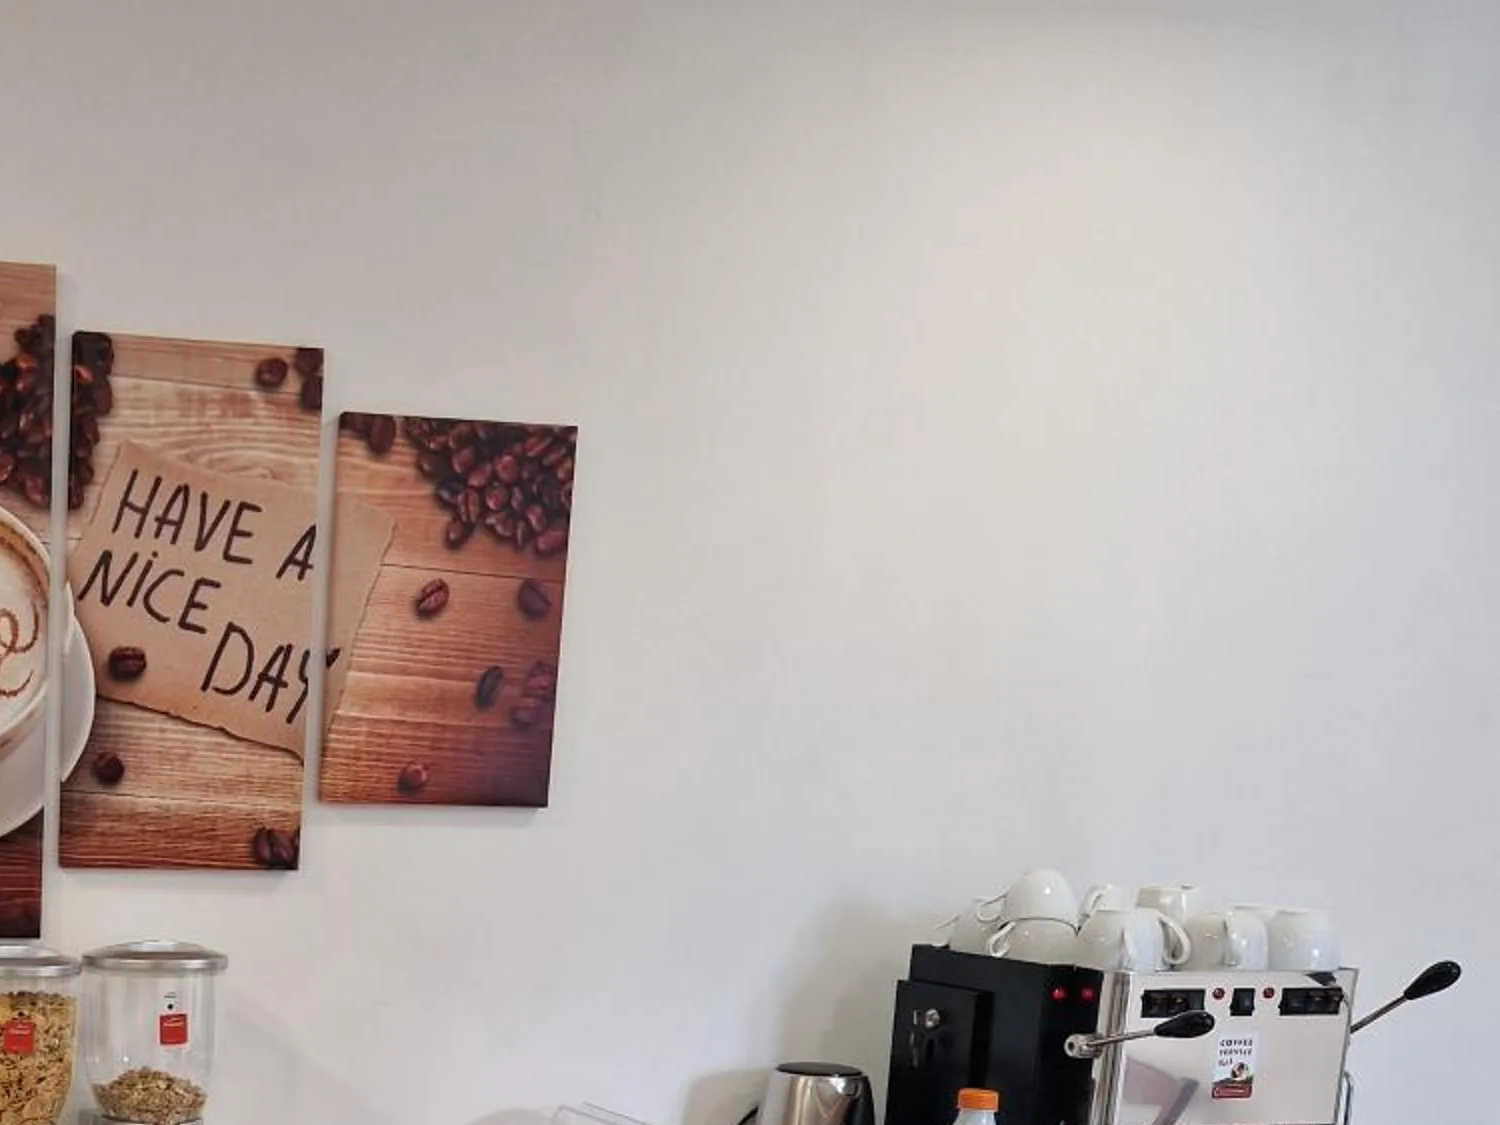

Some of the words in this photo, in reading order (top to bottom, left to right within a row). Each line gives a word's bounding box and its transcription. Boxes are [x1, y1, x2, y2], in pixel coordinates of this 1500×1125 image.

[111, 468, 262, 565] HAVE
[275, 523, 319, 582] A
[201, 622, 341, 725] DAY
